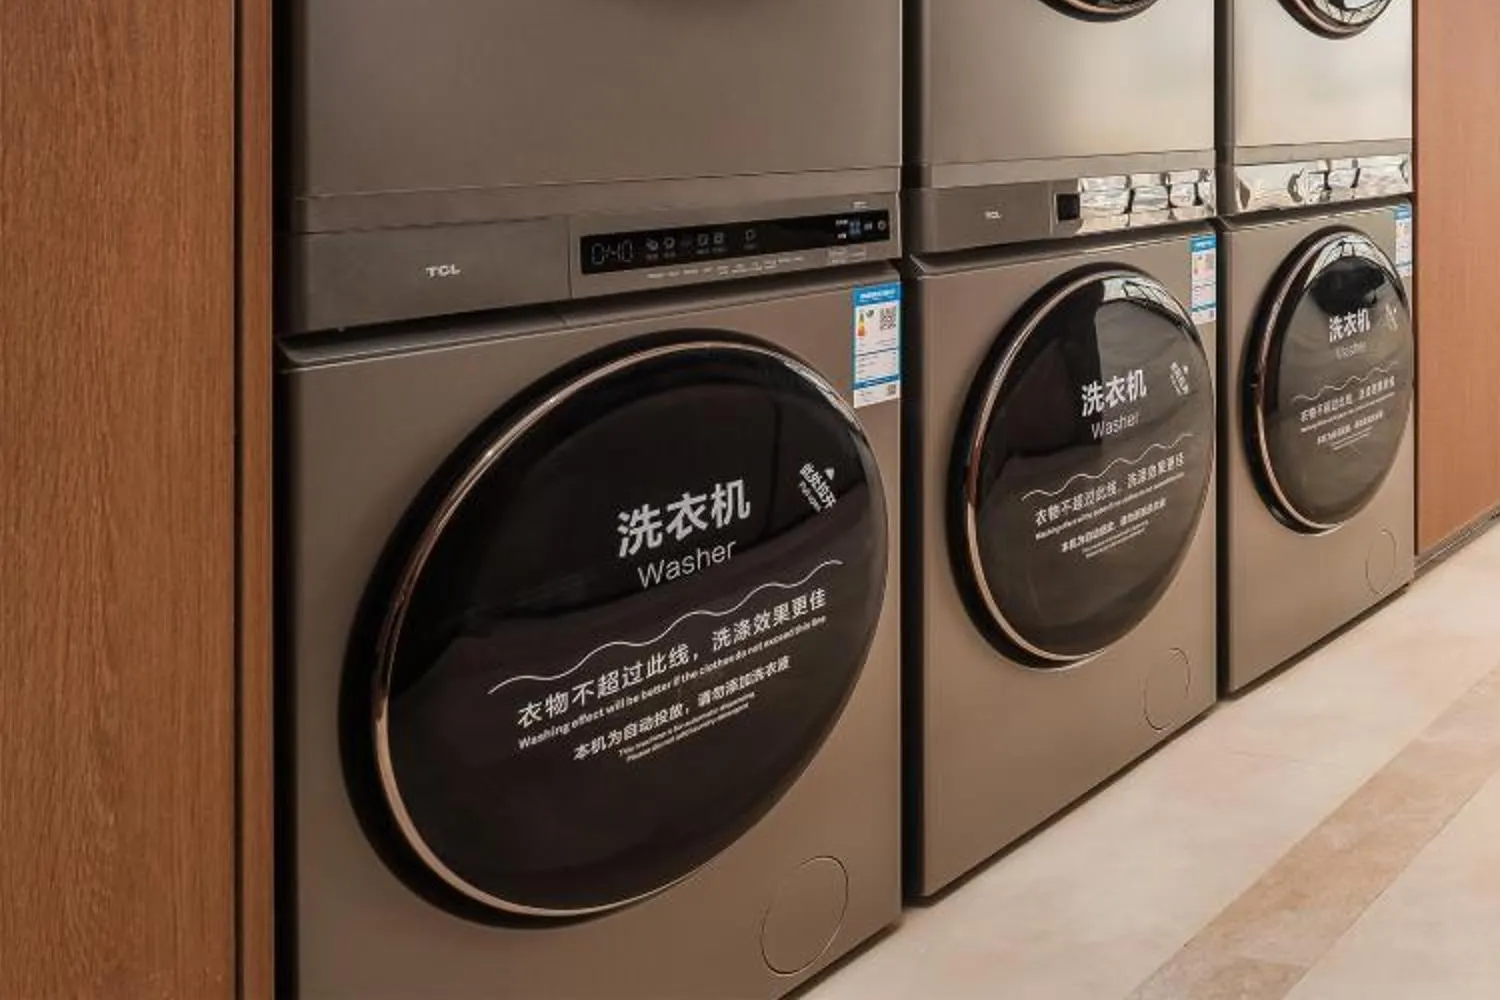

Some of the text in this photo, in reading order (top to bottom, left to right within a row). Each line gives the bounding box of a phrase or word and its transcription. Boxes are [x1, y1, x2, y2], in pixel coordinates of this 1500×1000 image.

[425, 264, 461, 278] TCL
[1329, 308, 1370, 342] 洗衣机
[1081, 368, 1147, 417] 洗衣机
[1091, 412, 1139, 440] Washer
[617, 479, 750, 557] 洗衣机
[637, 538, 737, 588] Washer
[518, 724, 571, 749] Washing
[572, 710, 605, 728] effect
[606, 698, 625, 714] will
[641, 680, 671, 700] better
[681, 670, 699, 683] the
